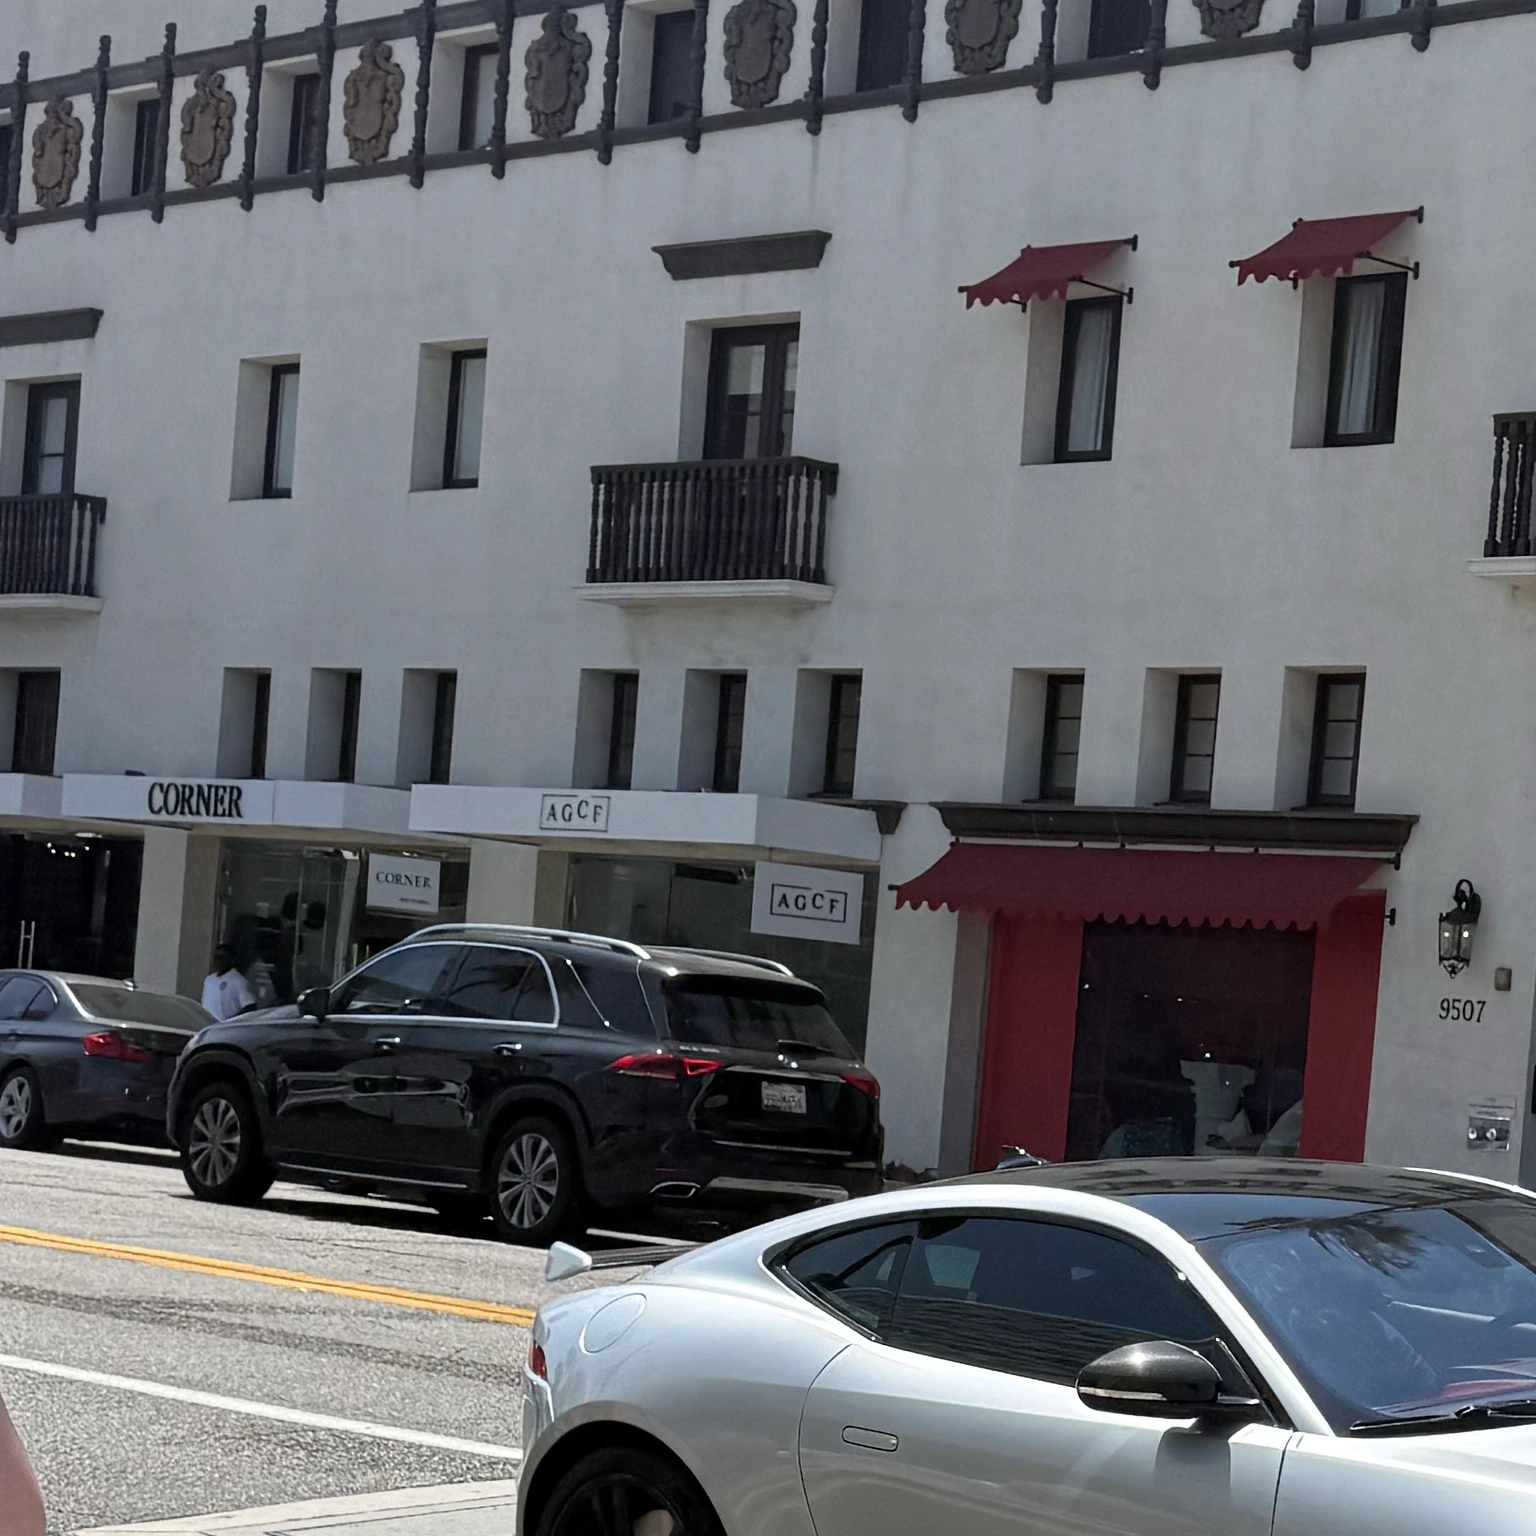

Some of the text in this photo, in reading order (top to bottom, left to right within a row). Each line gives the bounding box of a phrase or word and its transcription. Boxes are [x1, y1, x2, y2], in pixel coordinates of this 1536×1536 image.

[148, 782, 243, 818] CORNER
[546, 799, 603, 824] AGCF
[376, 871, 432, 889] CORNER
[778, 892, 840, 914] AGCF
[1439, 998, 1487, 1023] 9507
